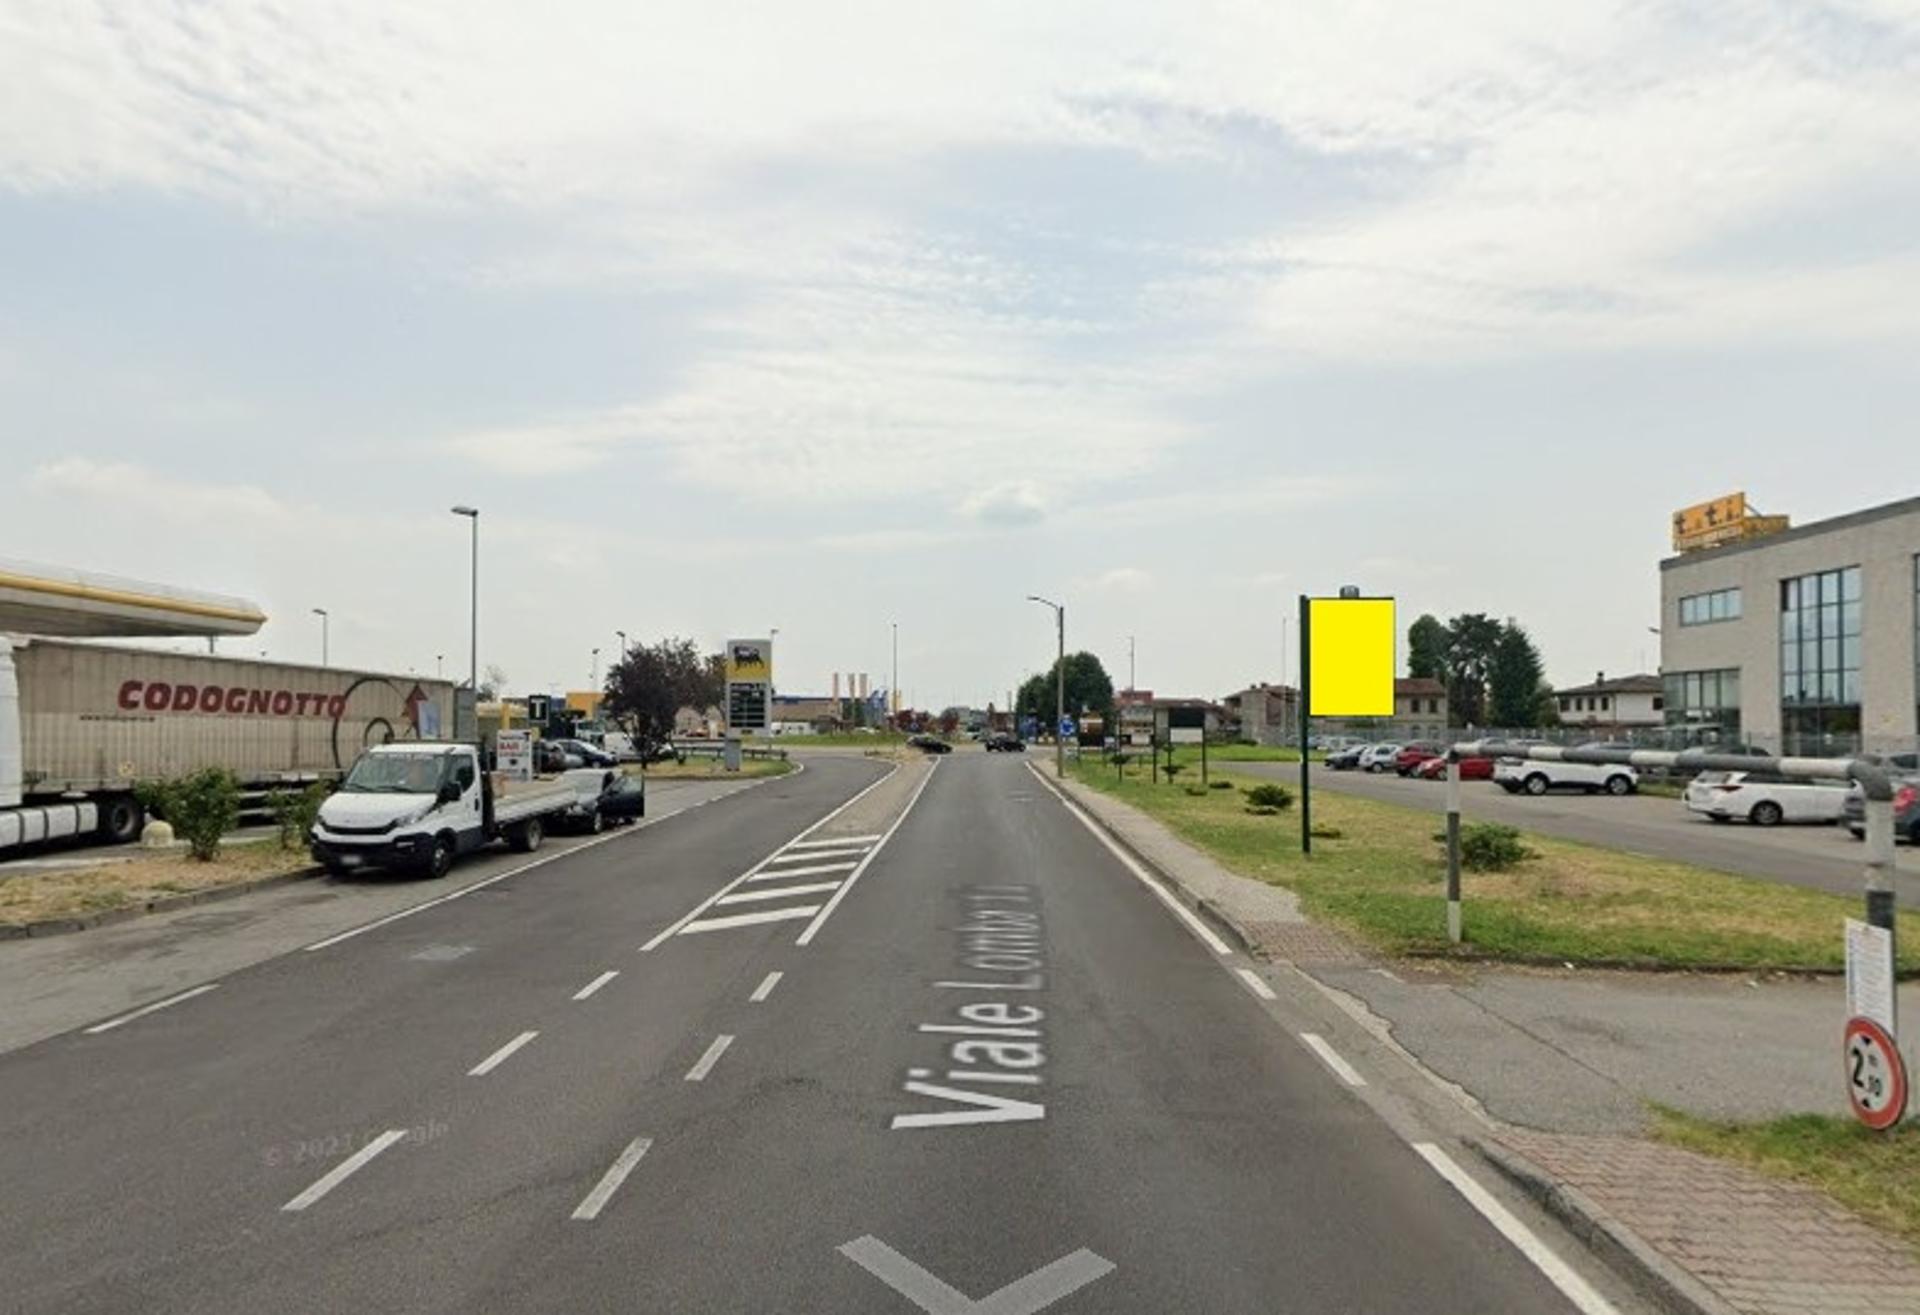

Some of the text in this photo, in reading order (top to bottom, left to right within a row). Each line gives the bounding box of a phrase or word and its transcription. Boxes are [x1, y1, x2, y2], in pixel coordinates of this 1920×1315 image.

[118, 680, 347, 718] CODOGNOTTO
[532, 699, 545, 718] T
[1851, 1045, 1864, 1088] 2
